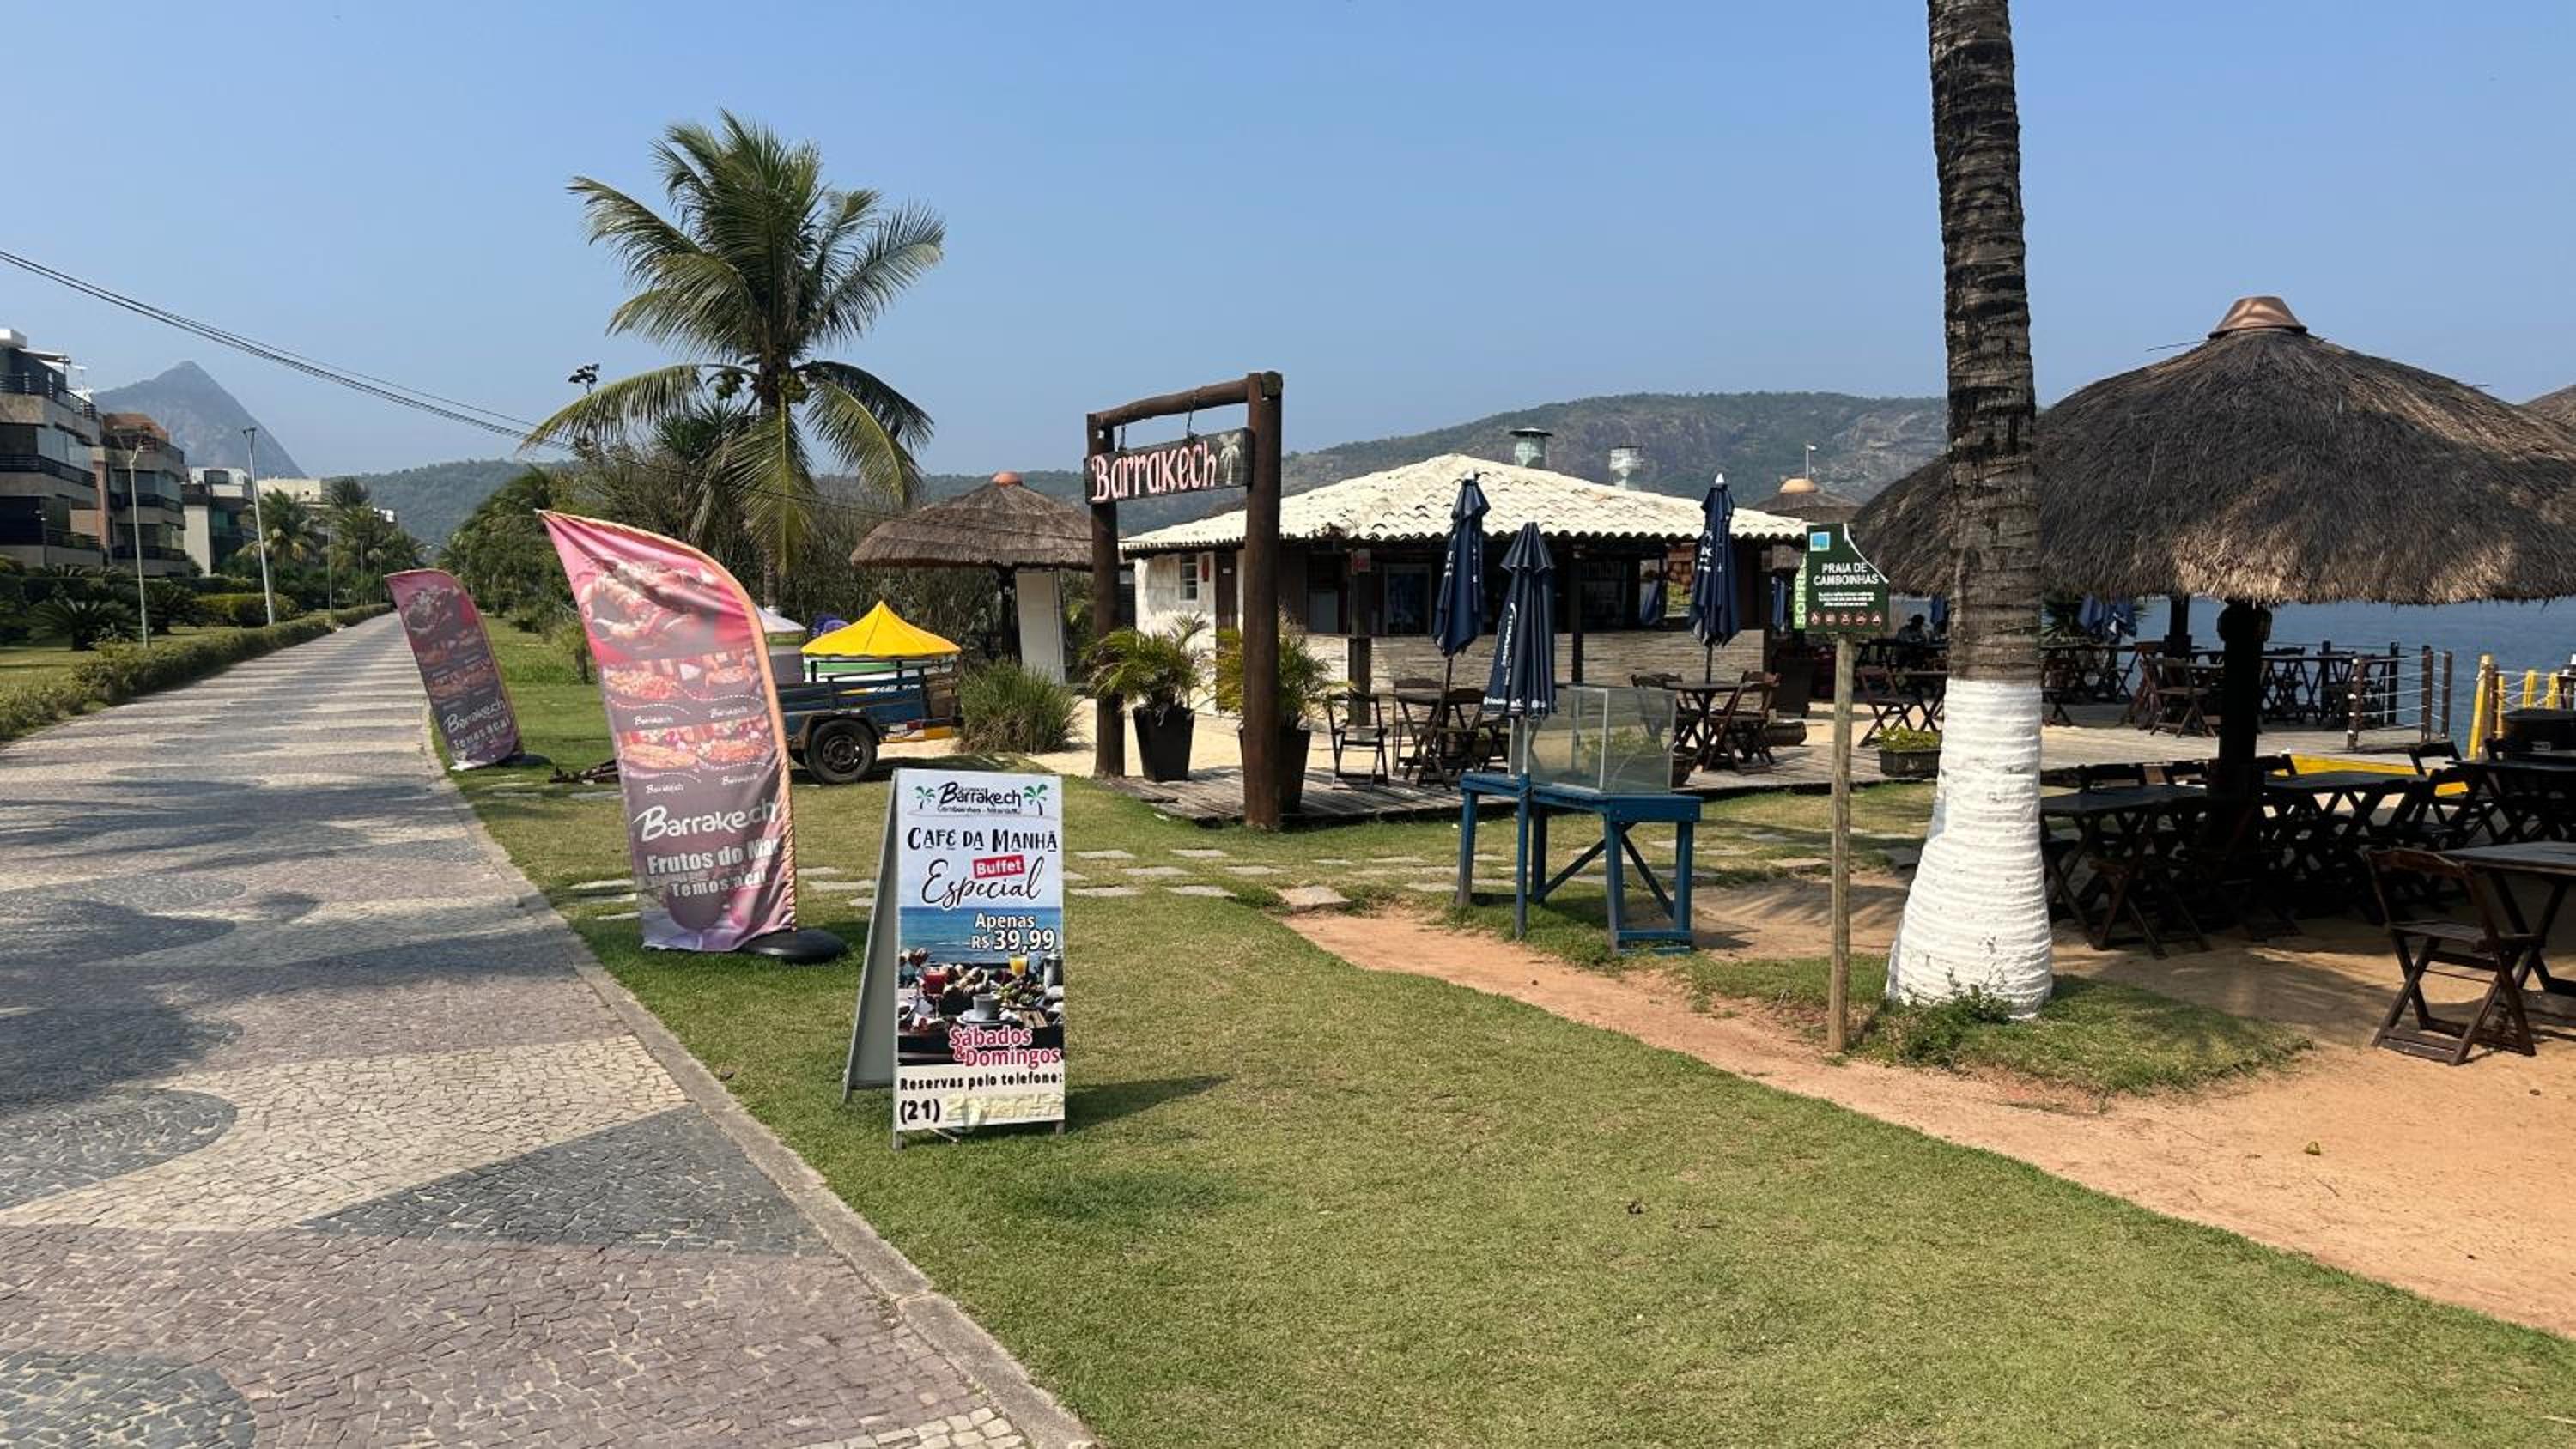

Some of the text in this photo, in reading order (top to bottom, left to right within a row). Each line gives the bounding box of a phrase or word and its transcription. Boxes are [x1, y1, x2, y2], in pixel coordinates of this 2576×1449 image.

[1091, 440, 1217, 501] Barrakech
[1813, 573, 1879, 585] CAMBOINHAS
[1821, 562, 1868, 574] PRAIA DE
[938, 781, 1021, 807] Barrakech
[632, 798, 775, 842] Barrakech
[963, 831, 984, 850] DA
[992, 829, 1058, 852] MANHÃ
[647, 851, 714, 876] Frutos
[718, 846, 744, 866] do
[976, 861, 1023, 876] Buffet
[671, 879, 730, 897] Temos
[921, 856, 1045, 908] Especial
[975, 913, 1035, 931] Apenas
[993, 930, 1055, 954] 39,99
[900, 1071, 1062, 1091] Reservas pelo telefone:
[899, 1099, 940, 1124] (21)
